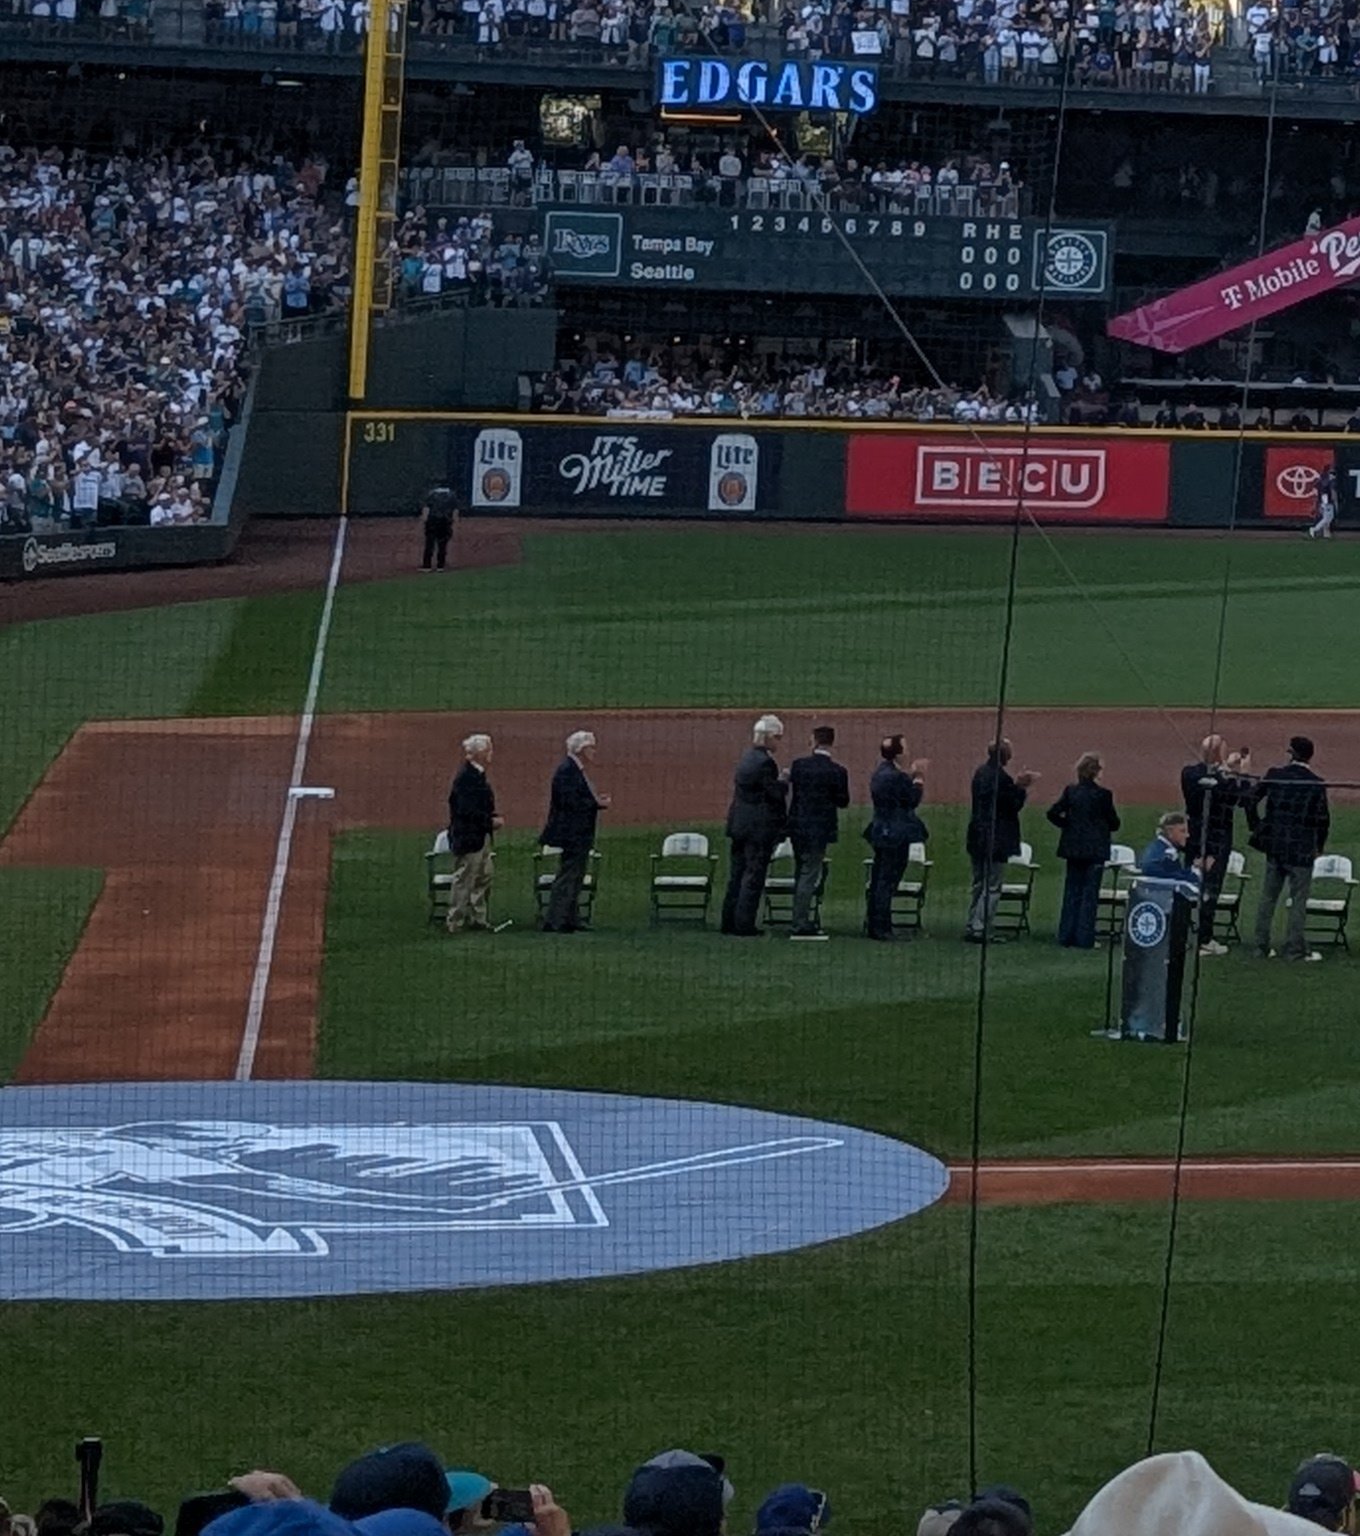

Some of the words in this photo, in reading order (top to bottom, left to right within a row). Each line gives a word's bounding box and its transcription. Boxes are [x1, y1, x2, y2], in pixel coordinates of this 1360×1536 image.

[660, 61, 875, 113] EDGAR'S
[731, 216, 739, 230] 1
[751, 216, 763, 231] 2
[774, 216, 785, 231] 3
[798, 217, 809, 232] 4
[821, 218, 832, 233] 5
[845, 219, 856, 234] 6
[868, 220, 879, 234] 7
[891, 221, 902, 235] 8
[914, 221, 925, 236] 9
[963, 223, 976, 238] R
[986, 224, 1000, 239] H
[1009, 225, 1022, 239] E
[632, 235, 681, 255] Tampa
[685, 237, 714, 255] Bay
[961, 246, 974, 263] 0
[984, 247, 997, 264] 0
[1008, 247, 1020, 264] 0
[630, 262, 695, 279] Seattle
[960, 272, 972, 290] 0
[983, 273, 996, 290] 0
[1006, 274, 1019, 291] 0
[1244, 258, 1321, 302] Mobile
[363, 422, 395, 442] 331
[591, 436, 639, 455] IT'S
[479, 437, 518, 463] Lite
[717, 443, 754, 469] Lite
[559, 447, 673, 495] Miller
[932, 461, 1091, 493] BECU
[609, 476, 667, 496] TIME
